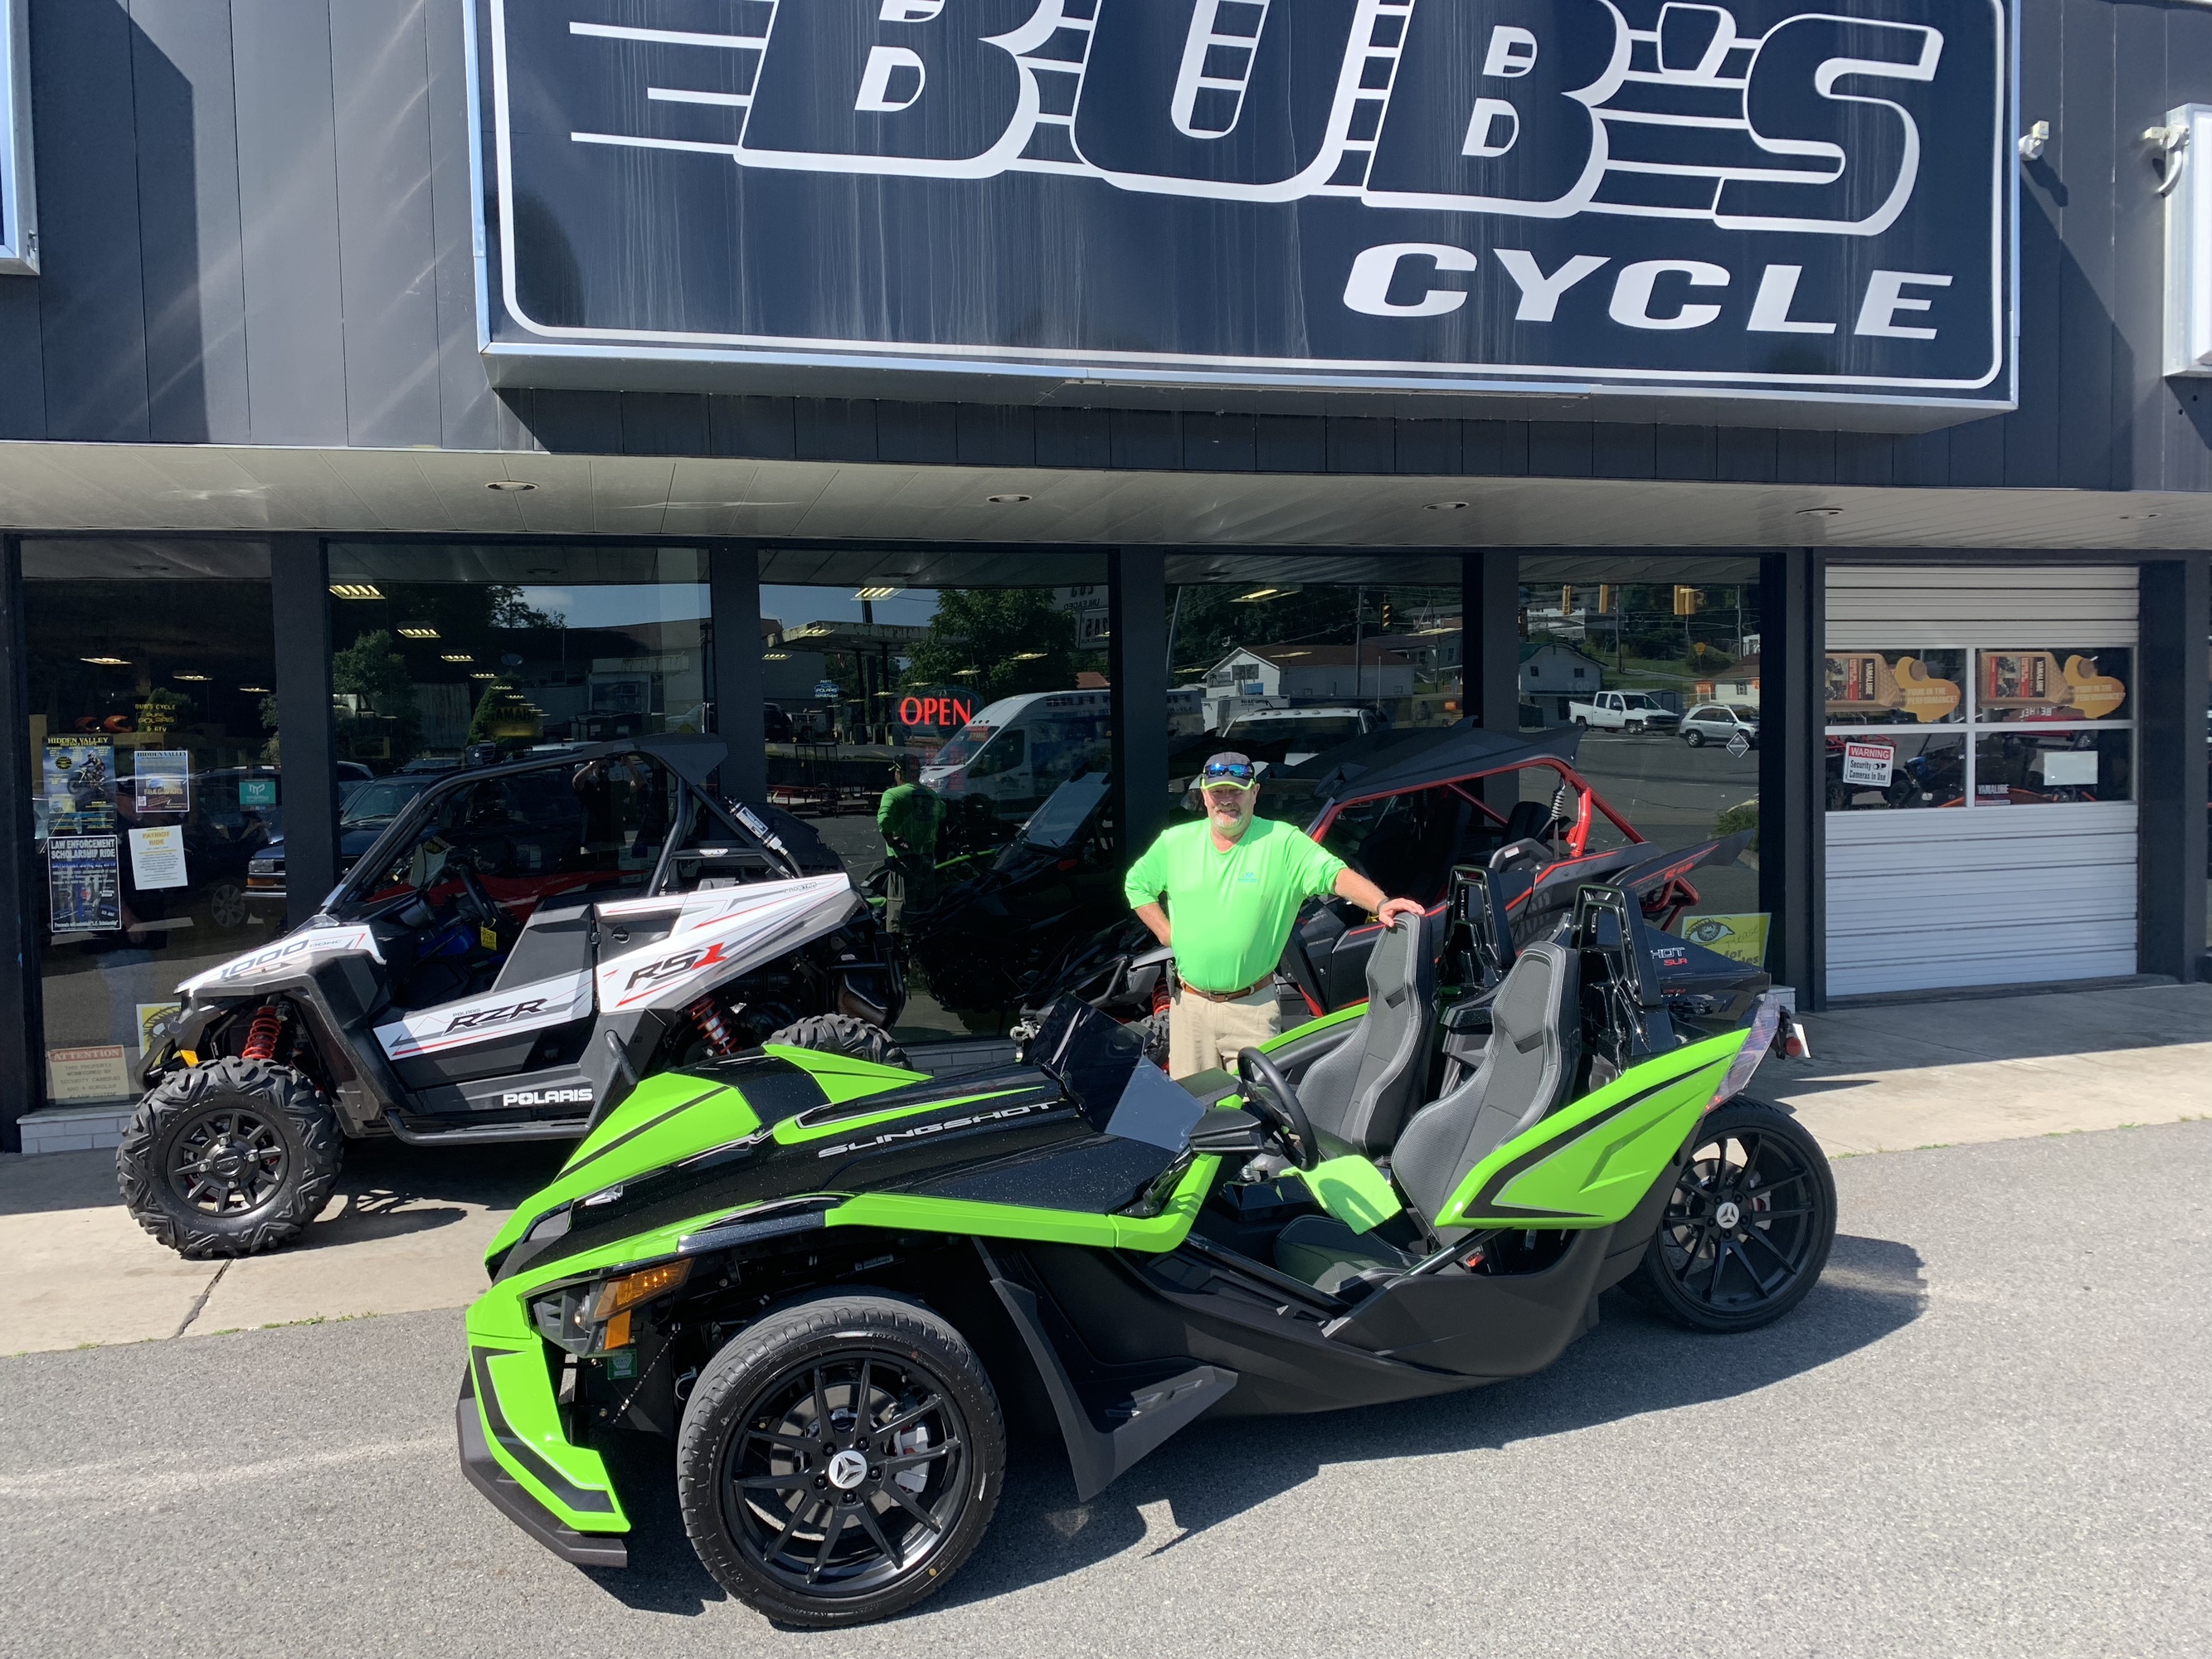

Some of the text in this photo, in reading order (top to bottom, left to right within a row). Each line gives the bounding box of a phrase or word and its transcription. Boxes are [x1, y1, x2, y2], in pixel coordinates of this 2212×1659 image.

[732, 0, 1944, 236] BUB'S
[1343, 243, 1954, 340] CYCLE
[1865, 662, 1874, 695] YAMALUBE
[1908, 688, 1925, 696] POUR
[1933, 687, 1947, 695] THE
[1908, 695, 1957, 704] PERFORMANCE!
[900, 696, 971, 726] OPEN
[1851, 747, 1889, 759] WARNING
[1850, 760, 1871, 771] Security
[1850, 770, 1870, 780] Cameras
[1877, 772, 1886, 781] Use
[1978, 784, 2010, 795] YAMALUBE
[51, 839, 115, 850] LAW ENFORCEMENT
[51, 849, 116, 859] SCHOLARSHIP RIDE
[783, 882, 818, 893] PROSTAR
[309, 939, 343, 948] DOHC
[220, 939, 309, 979] 1000
[1724, 950, 1743, 959] for
[624, 941, 727, 991] RS1
[1663, 957, 1689, 966] SLR
[441, 998, 548, 1037] RZR
[452, 1008, 481, 1017] POLARIS
[53, 1049, 120, 1061] ATTENTION
[503, 1088, 593, 1107] POLARIS
[818, 1100, 1058, 1159] SLINGSHOT
